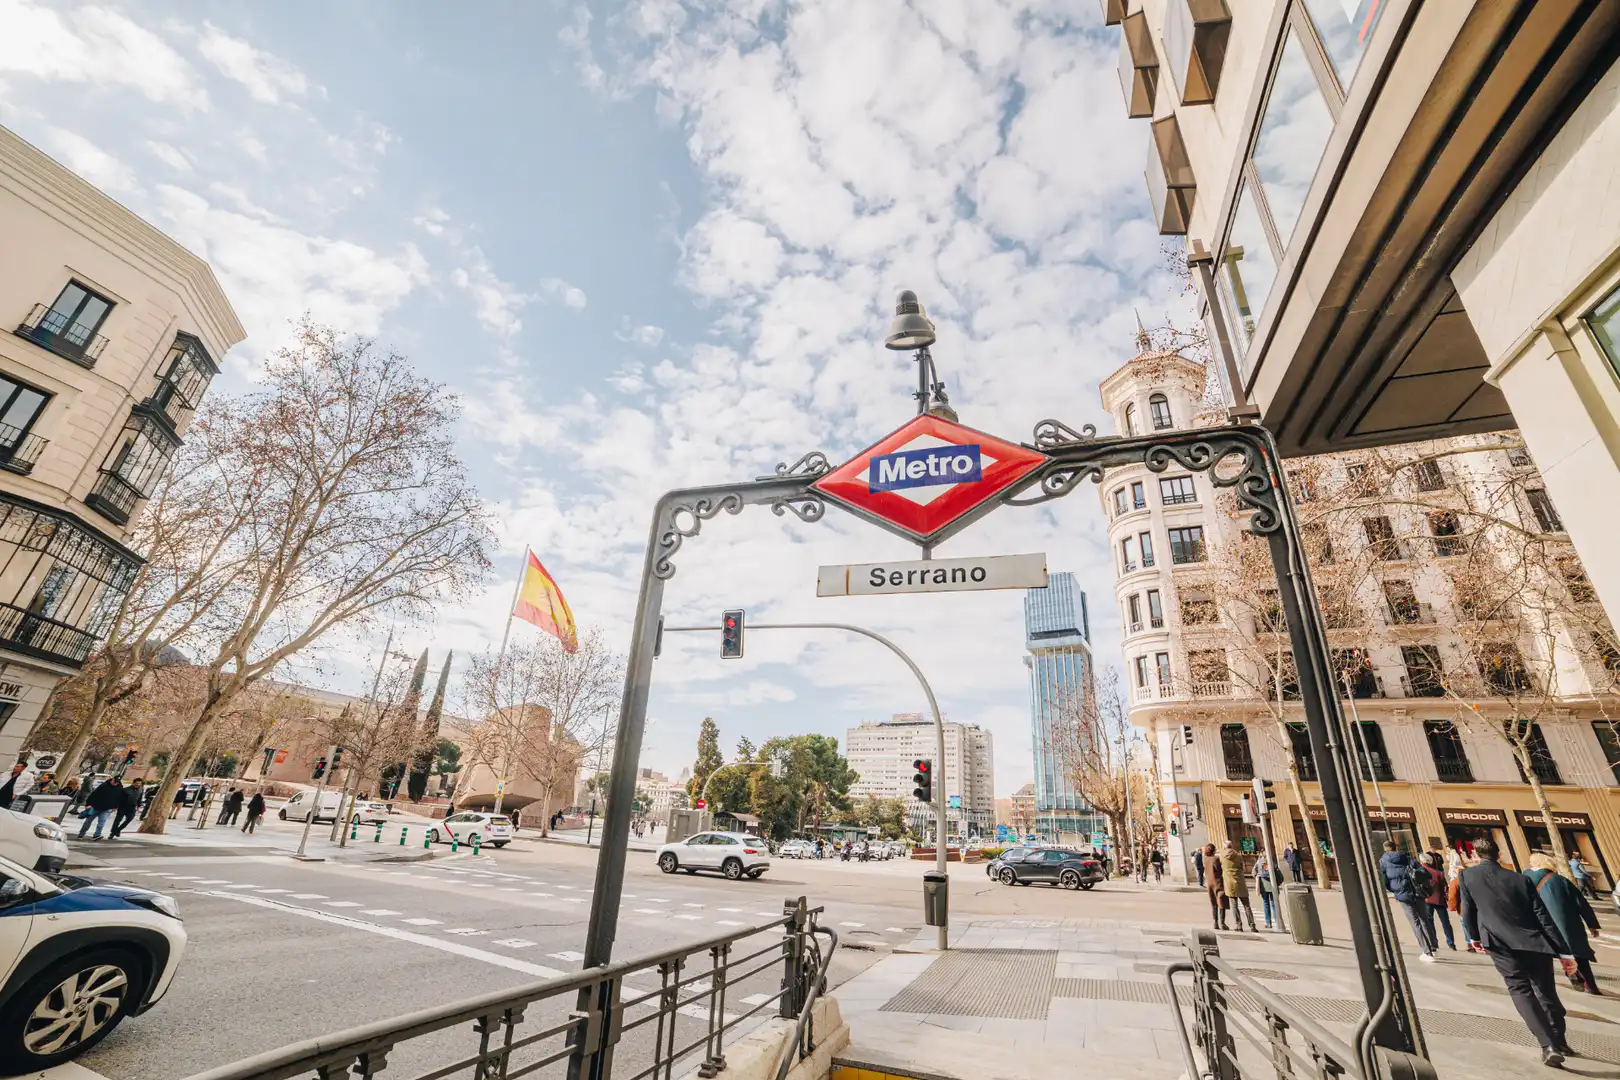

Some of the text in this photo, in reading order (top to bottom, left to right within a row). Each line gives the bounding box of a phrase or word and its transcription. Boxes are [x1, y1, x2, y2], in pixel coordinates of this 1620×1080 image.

[879, 454, 974, 483] Metro
[869, 566, 987, 587] Serrano
[1445, 812, 1501, 821] PERODRI
